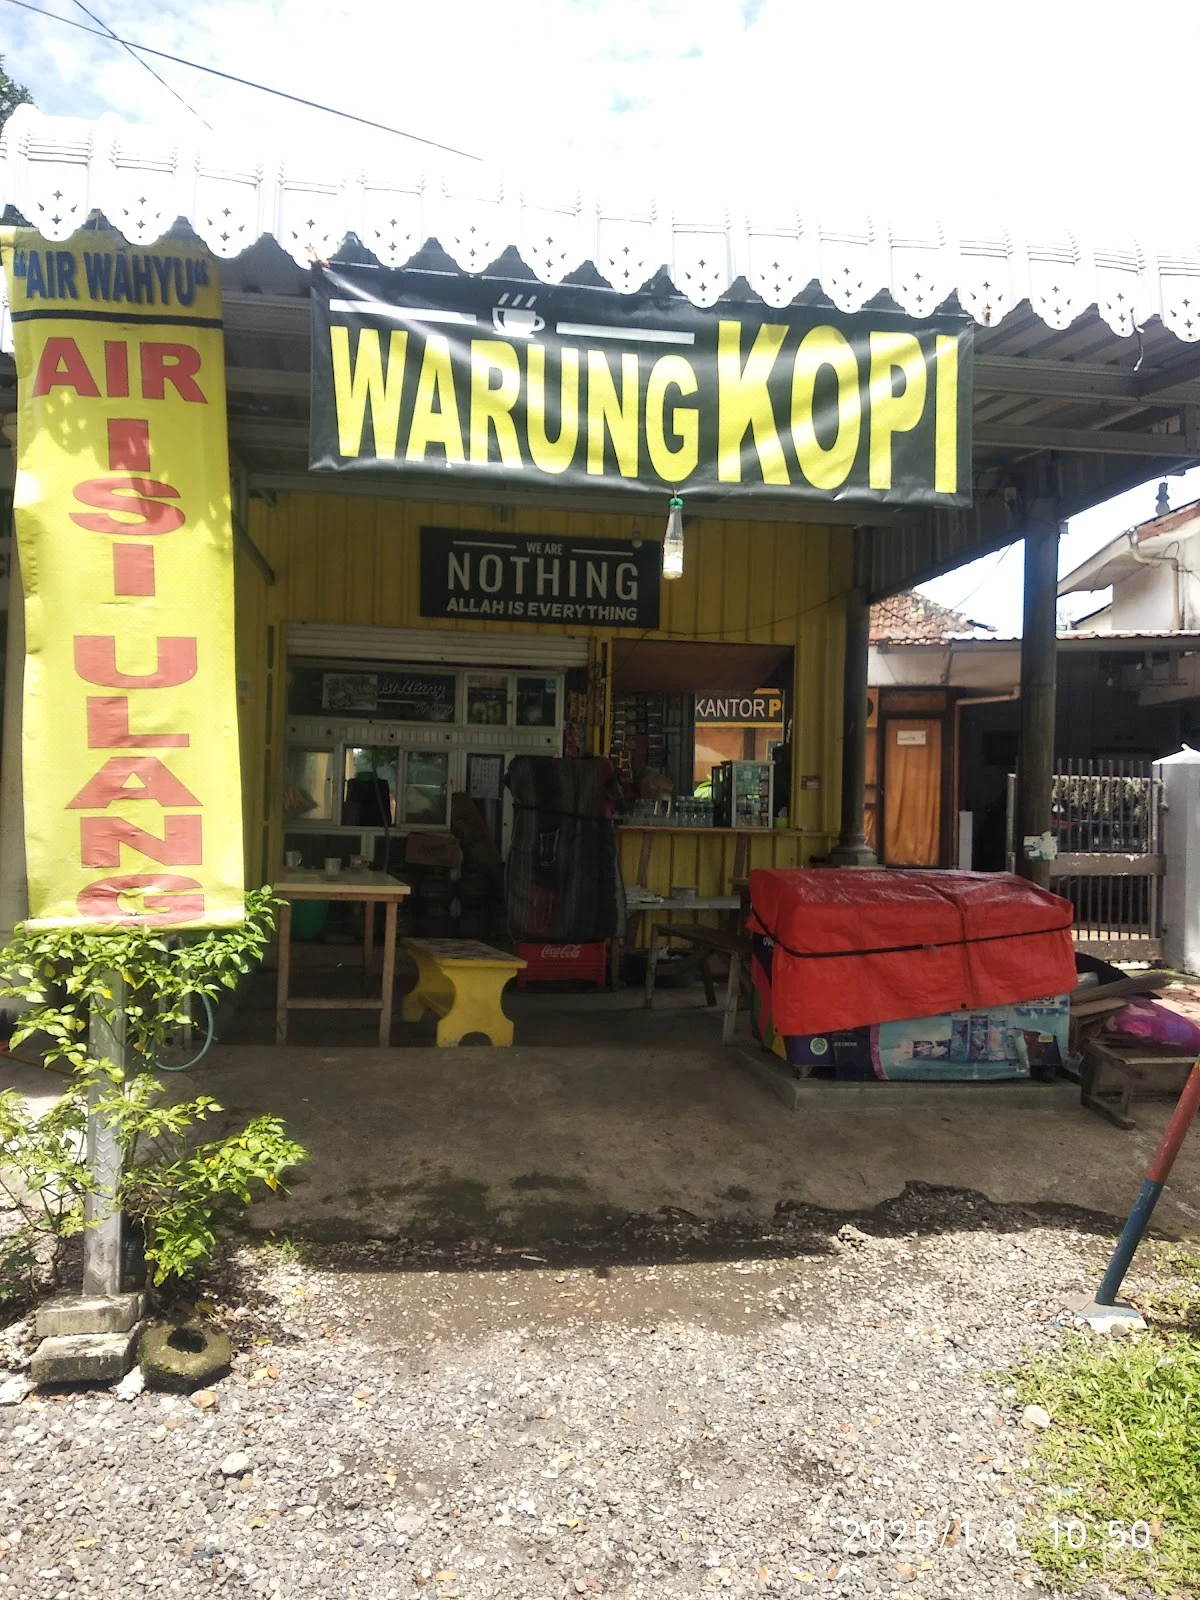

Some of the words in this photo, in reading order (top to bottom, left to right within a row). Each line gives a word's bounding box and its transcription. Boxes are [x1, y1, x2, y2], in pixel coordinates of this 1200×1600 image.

[32, 337, 208, 404] AIR
[329, 325, 699, 482] WARUNG
[717, 320, 958, 494] KOPI
[68, 418, 186, 596] ISI
[448, 551, 639, 601] NOTHING
[526, 541, 543, 554] WE
[544, 543, 563, 556] ARE
[446, 597, 504, 615] ALLAH
[507, 600, 525, 616] IS
[527, 602, 638, 621] EVERYTHING
[696, 698, 766, 718] KANTOR
[64, 635, 205, 926] ULANG
